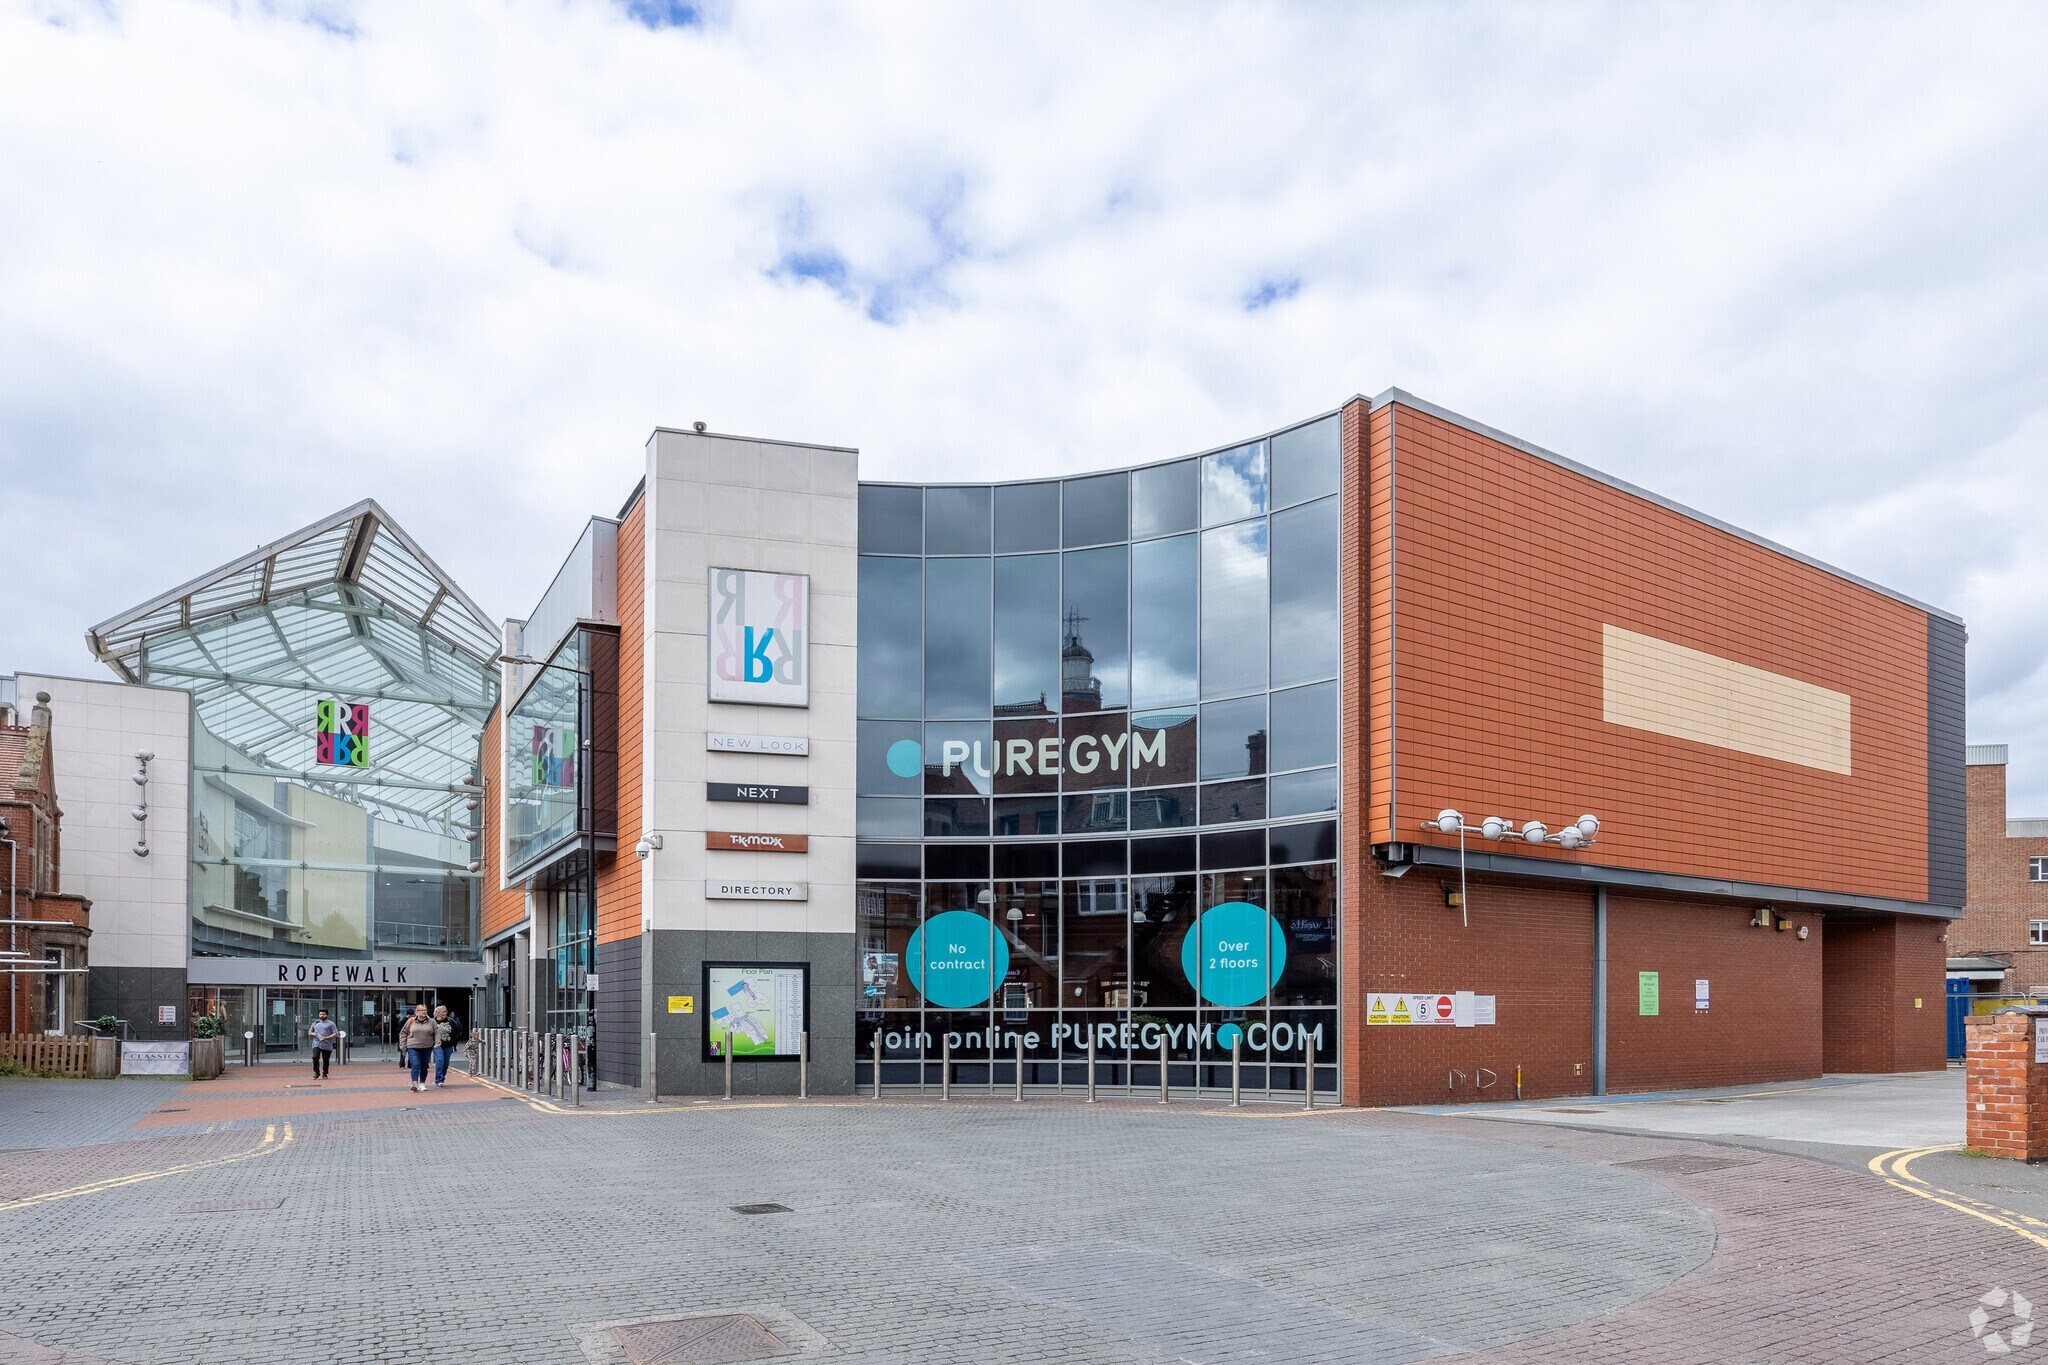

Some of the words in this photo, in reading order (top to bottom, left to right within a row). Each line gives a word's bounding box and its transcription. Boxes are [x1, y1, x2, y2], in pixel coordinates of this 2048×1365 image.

[714, 738, 751, 748] NEW
[760, 741, 804, 751] LOOK
[942, 728, 1167, 778] PUREGYM
[737, 787, 779, 799] NEXT
[721, 885, 793, 895] DIRECTORY
[949, 943, 967, 954] No
[1218, 940, 1249, 952] Over
[930, 959, 986, 970] contract
[1209, 958, 1216, 969] 2
[1220, 957, 1259, 969] floors
[278, 964, 407, 983] ROPEWALK
[1420, 1003, 1427, 1014] 5
[869, 1025, 932, 1050] Join
[948, 1025, 1041, 1050] online
